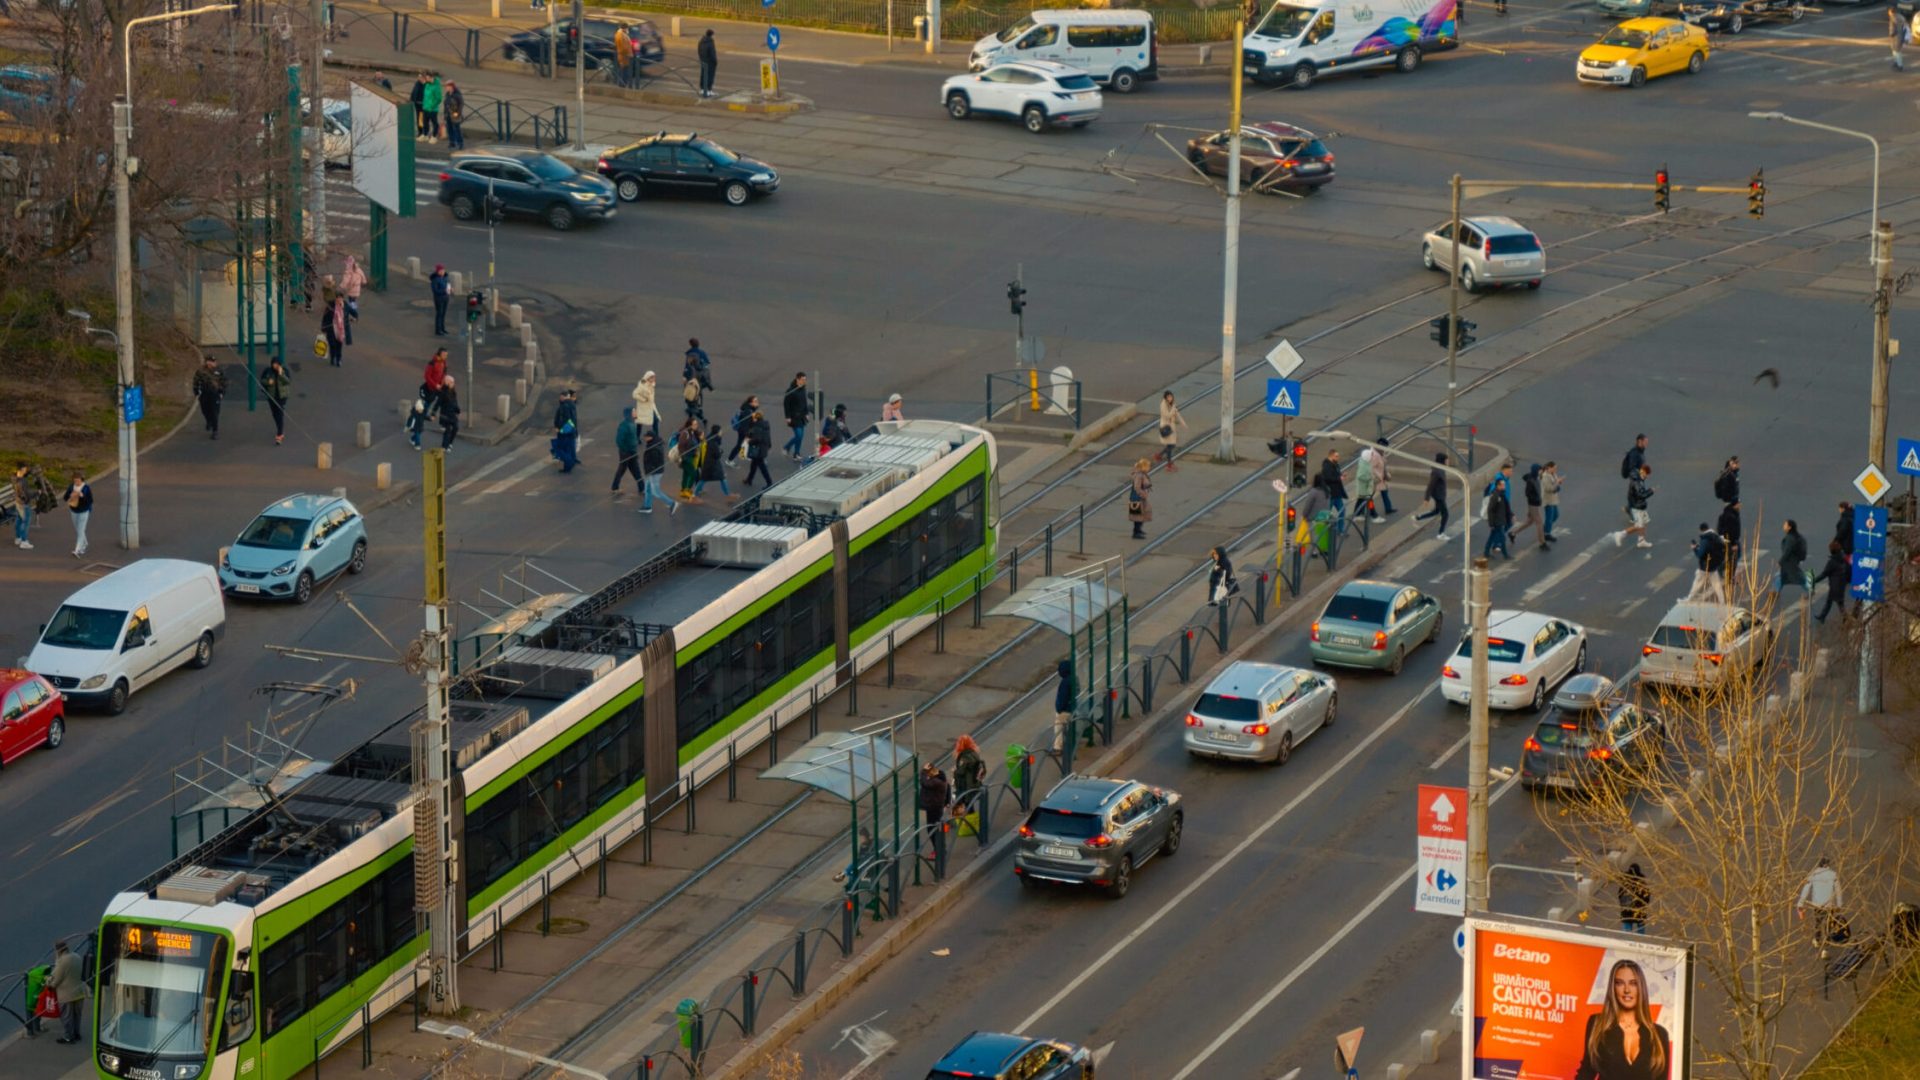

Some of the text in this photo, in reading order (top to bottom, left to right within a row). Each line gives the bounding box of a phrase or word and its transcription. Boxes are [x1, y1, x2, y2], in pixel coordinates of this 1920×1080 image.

[1420, 893, 1461, 905] Carrefour
[129, 928, 141, 945] 41
[1493, 943, 1551, 964] Betano
[1493, 972, 1551, 992] URMĂTORUL
[1492, 985, 1578, 1013] CASINO HIT
[1492, 1003, 1564, 1024] POATE FI AL TĂU
[129, 1066, 161, 1079] IMPERIO
